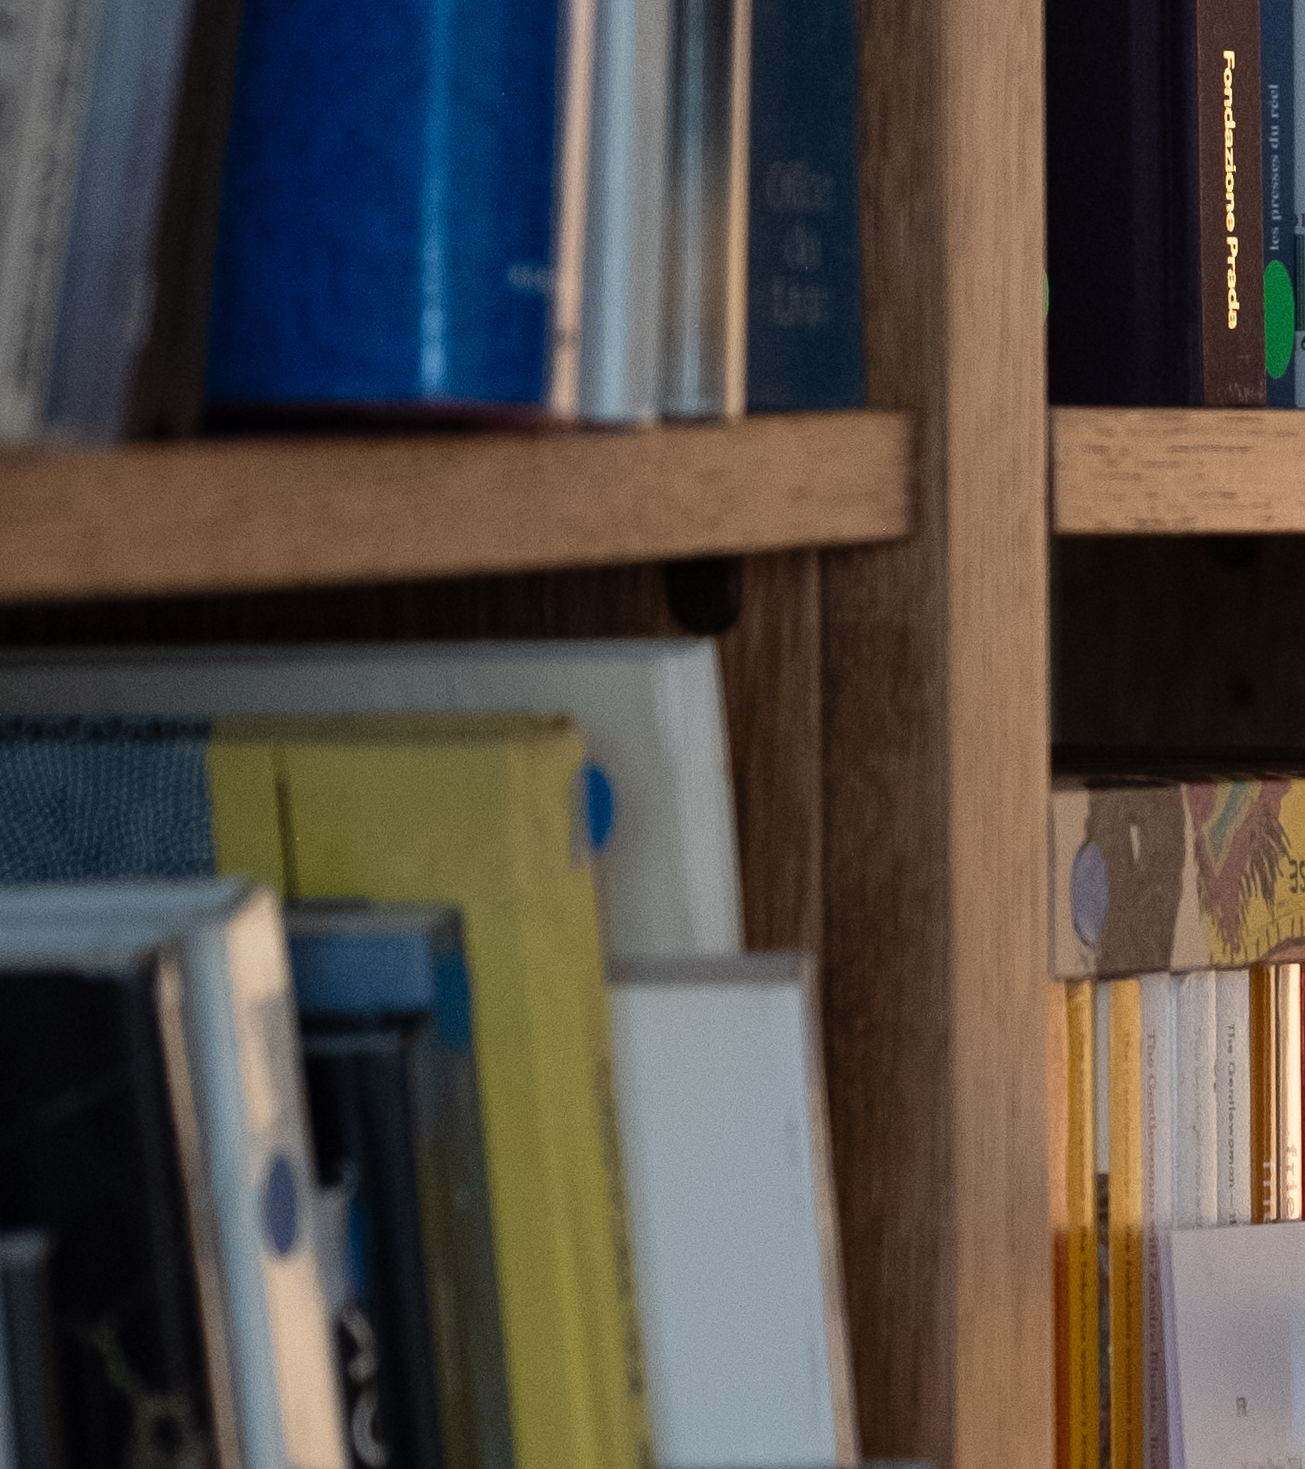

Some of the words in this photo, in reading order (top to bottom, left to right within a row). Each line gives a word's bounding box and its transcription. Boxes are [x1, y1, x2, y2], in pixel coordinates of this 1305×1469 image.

[1266, 83, 1280, 118] réel
[1222, 50, 1237, 233] Fondazione
[1267, 123, 1280, 150] du
[1267, 155, 1281, 221] presses
[1267, 228, 1281, 251] les
[1227, 236, 1241, 331] Prada
[1145, 1029, 1157, 1069] The
[1226, 1023, 1237, 1055] The
[1145, 1074, 1158, 1213] Gentlewoman
[1226, 1061, 1238, 1188] Gentlewoman
[1147, 1219, 1159, 1263] with
[1147, 1270, 1159, 1342] Zandra
